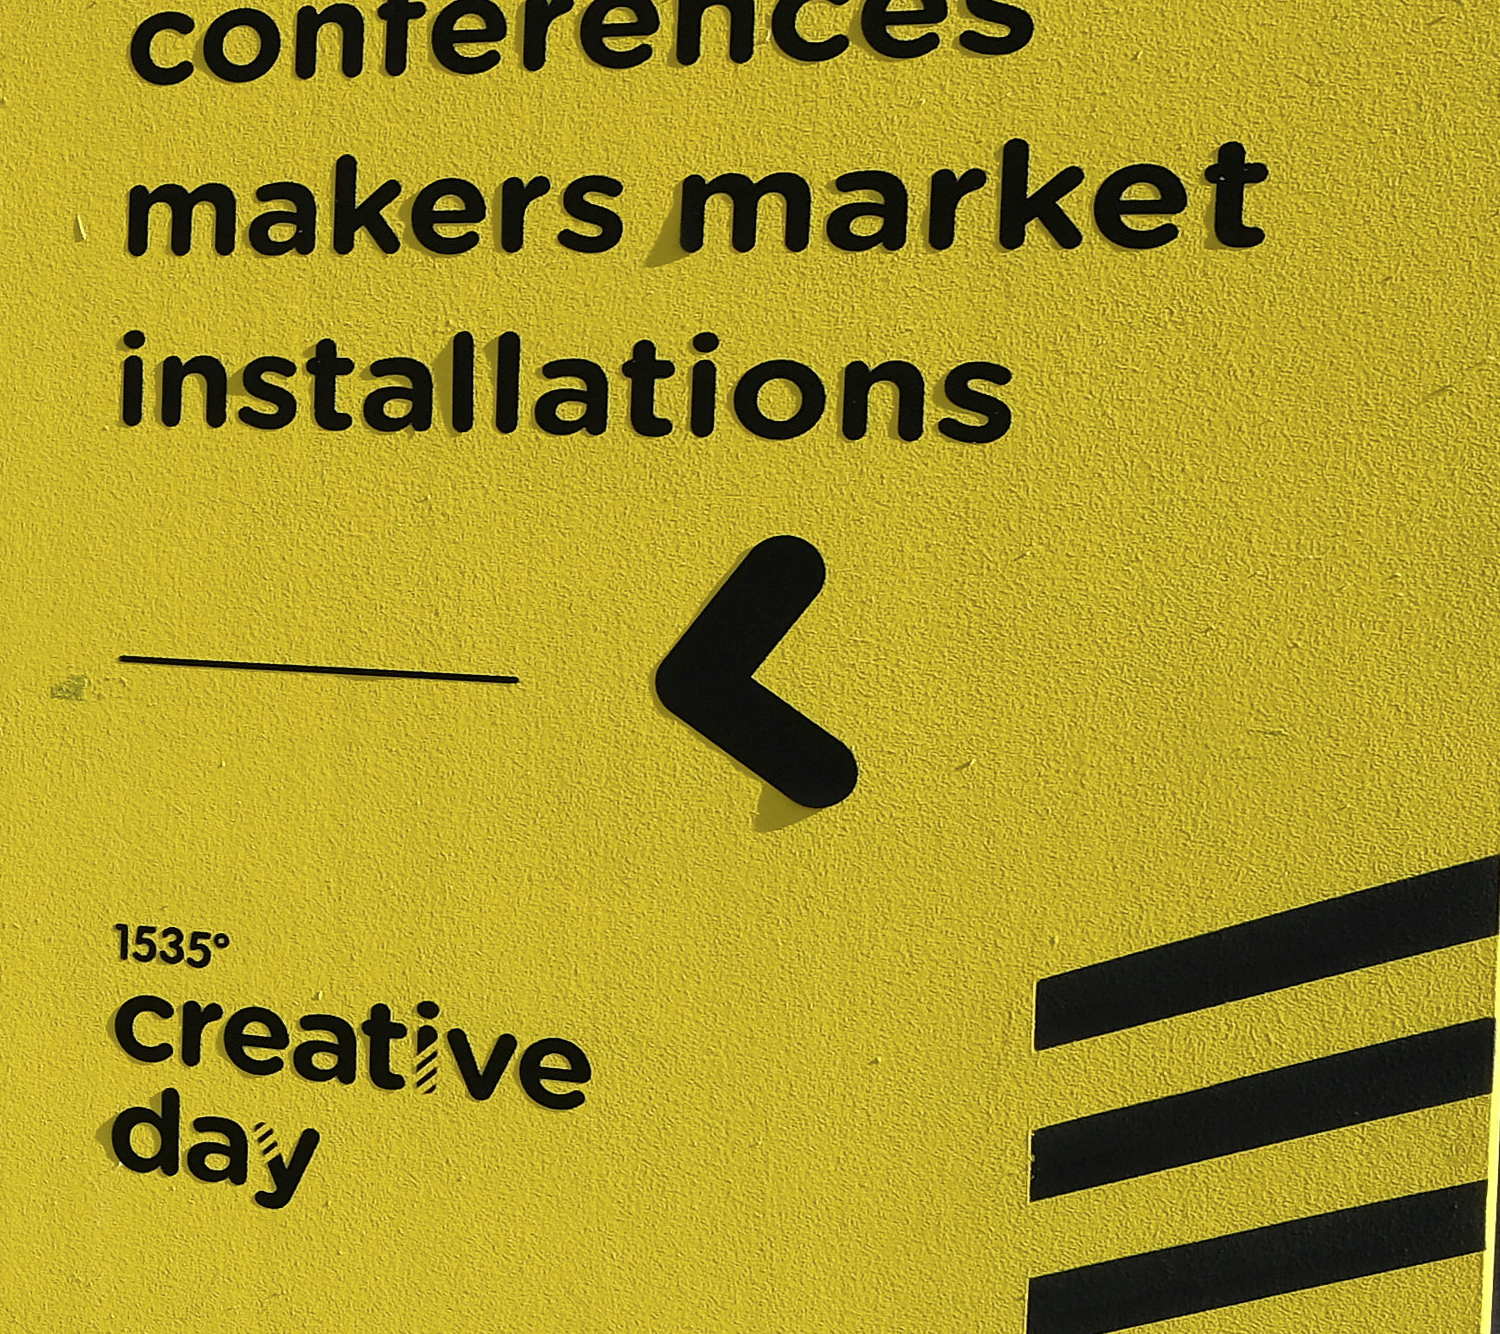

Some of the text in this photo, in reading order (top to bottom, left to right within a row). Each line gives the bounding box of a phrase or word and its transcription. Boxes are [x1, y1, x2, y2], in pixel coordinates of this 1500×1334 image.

[126, 137, 1270, 257] makers market
[121, 330, 1013, 444] installations
[114, 923, 230, 968] 1535°
[113, 995, 592, 1111] creative
[110, 1087, 320, 1210] day
